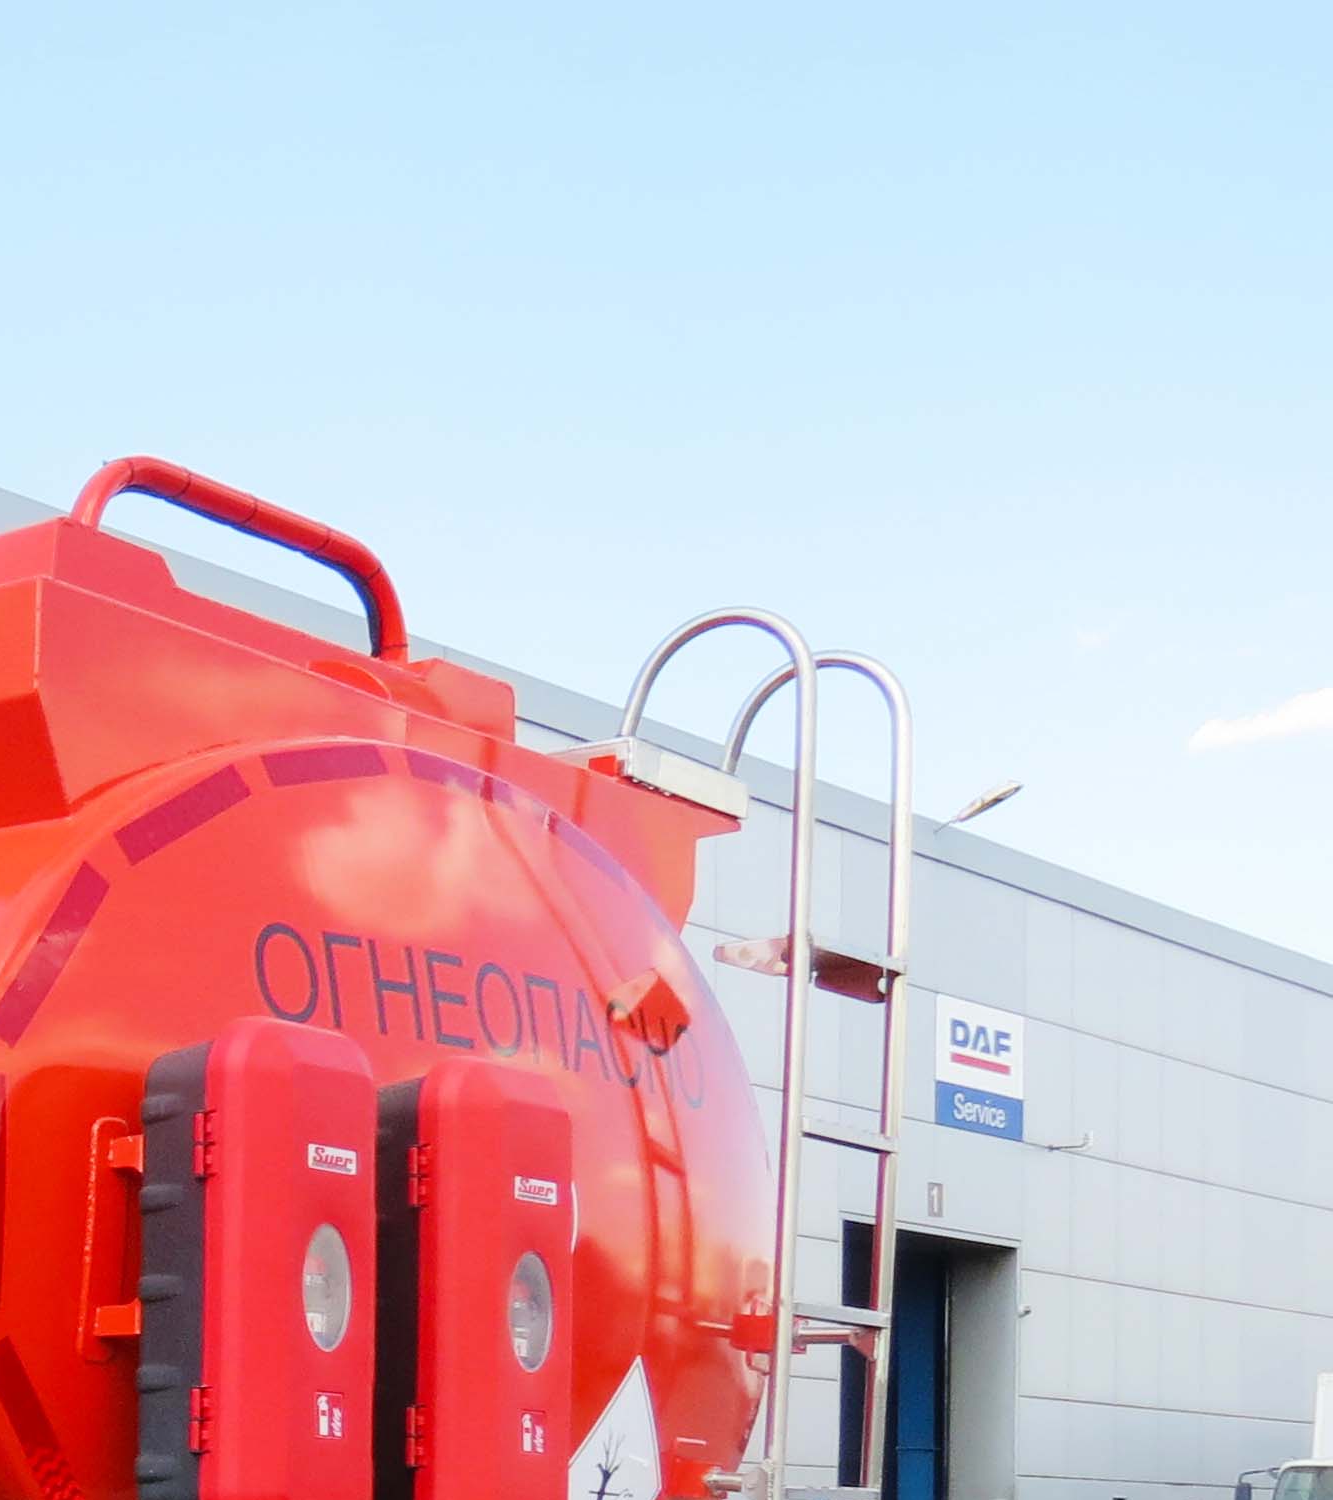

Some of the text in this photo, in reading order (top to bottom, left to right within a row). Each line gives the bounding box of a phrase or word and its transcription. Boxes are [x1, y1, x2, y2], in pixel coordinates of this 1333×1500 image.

[254, 922, 704, 1109] ОГНЕОПАСНО
[950, 1018, 1012, 1057] DAF
[953, 1093, 1006, 1129] Service
[312, 1146, 353, 1171] Suer
[517, 1177, 554, 1198] Suer
